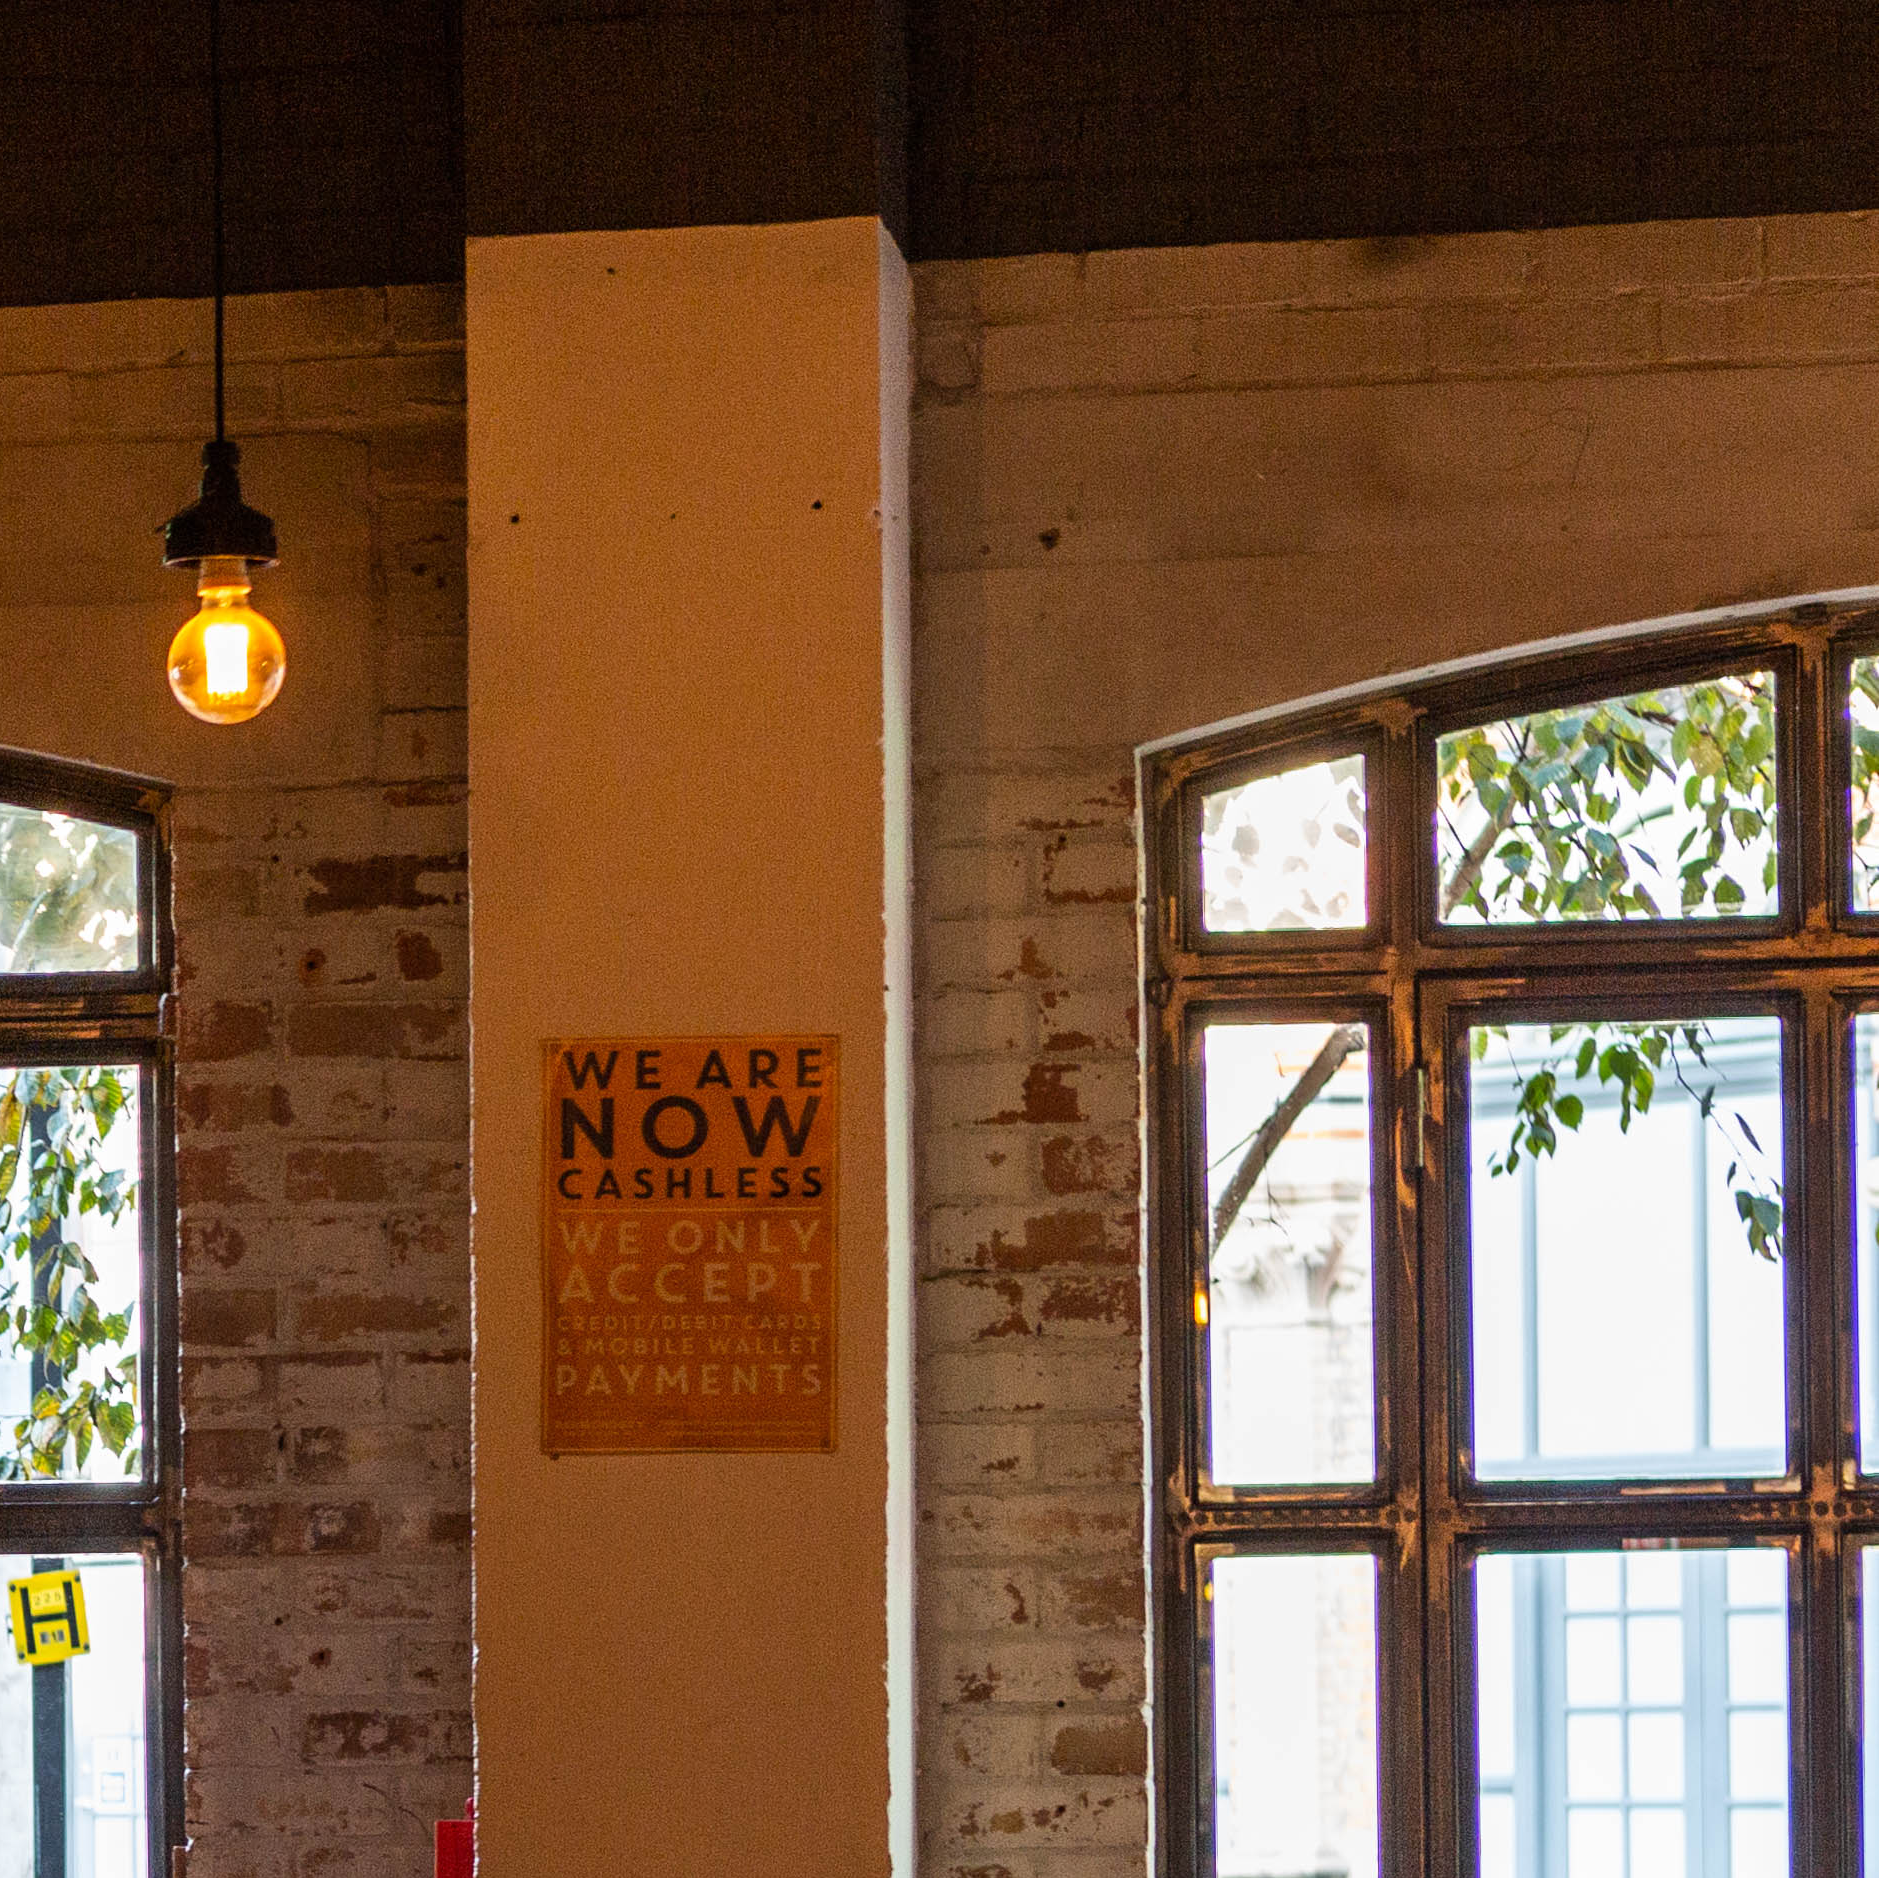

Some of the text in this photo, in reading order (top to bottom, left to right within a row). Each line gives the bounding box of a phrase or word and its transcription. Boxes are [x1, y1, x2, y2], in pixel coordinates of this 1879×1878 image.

[563, 1048, 823, 1091] WE ARE
[560, 1095, 823, 1160] NOW
[557, 1166, 823, 1200] CASHLESS
[560, 1219, 820, 1254] WE ONLY
[558, 1262, 822, 1303] ACCEPT
[556, 1337, 821, 1356] & MOBILE WALLET
[556, 1363, 822, 1396] PAYMENTS
[20, 1581, 81, 1654] H
